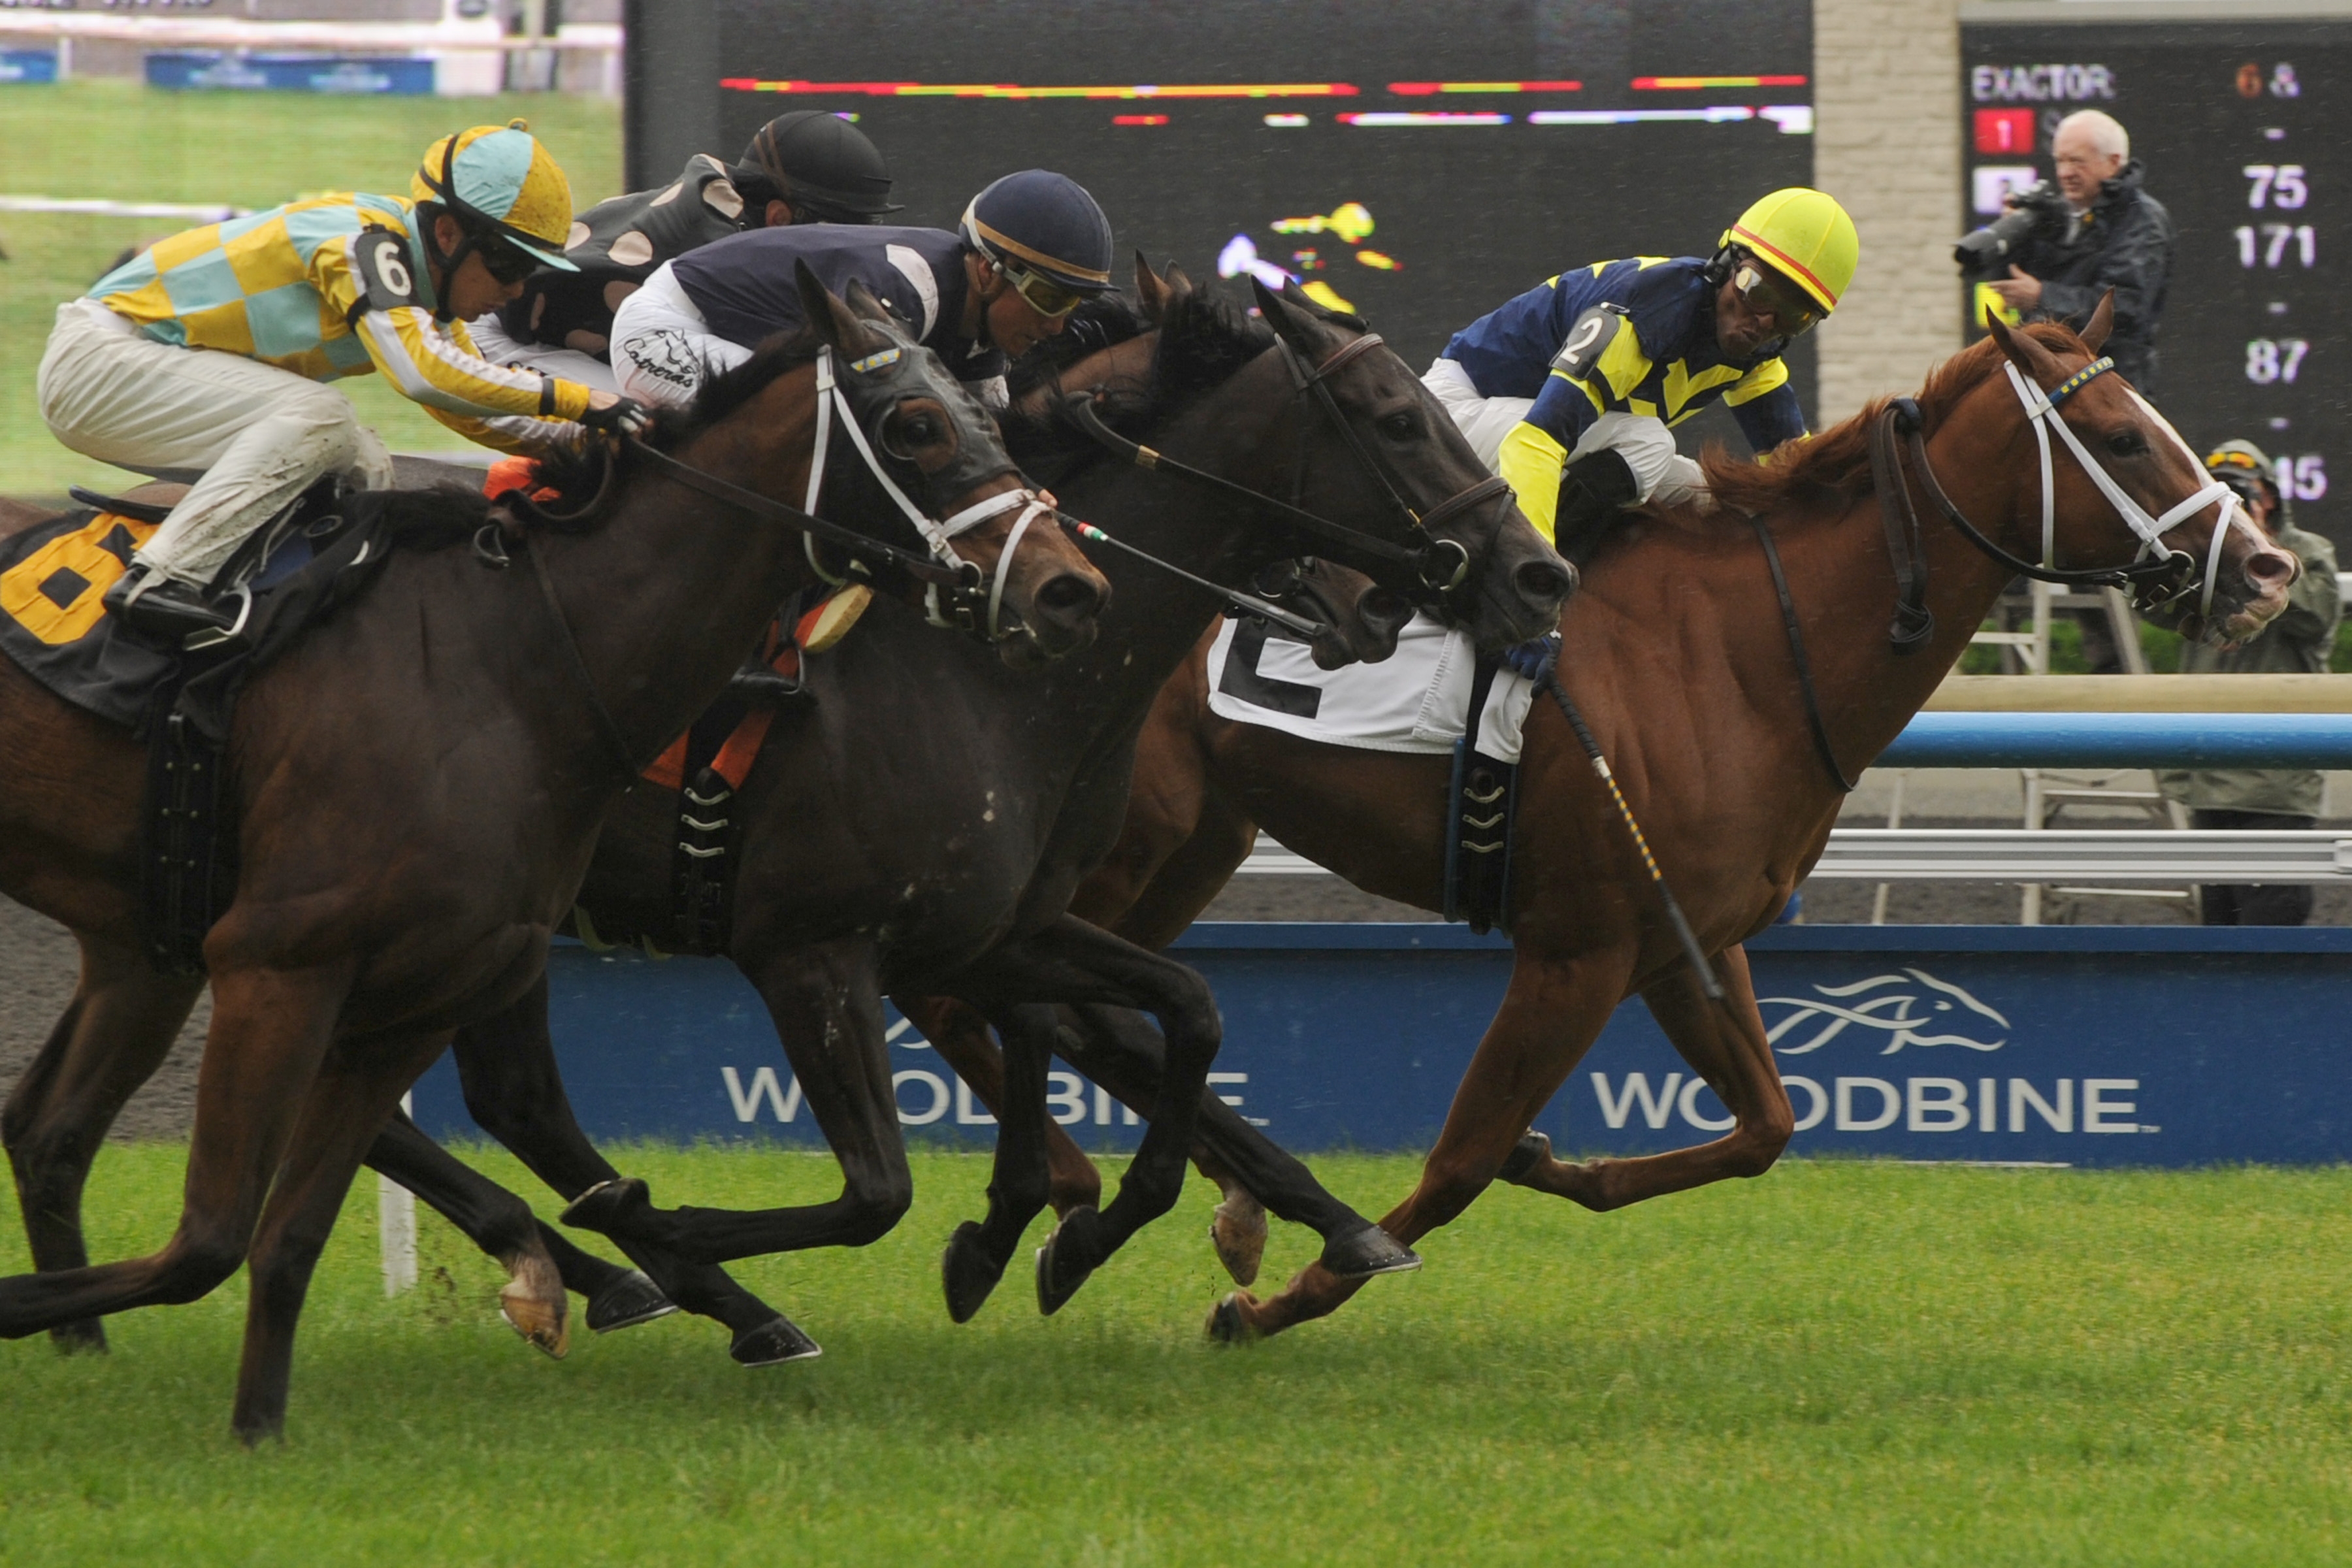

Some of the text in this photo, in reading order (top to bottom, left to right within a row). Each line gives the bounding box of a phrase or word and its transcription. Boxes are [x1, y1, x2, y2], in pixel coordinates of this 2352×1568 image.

[1970, 63, 2116, 101] EXACTOR
[2236, 63, 2300, 98] 6 &
[1995, 119, 2012, 150] 1
[2242, 165, 2308, 209] 75
[374, 241, 412, 297] 6
[2234, 225, 2316, 268] 171
[1560, 316, 1603, 365] 2
[2246, 338, 2310, 384] 87
[721, 1066, 1249, 1125] WOBIE
[1590, 1072, 2140, 1133] WOODBINE
